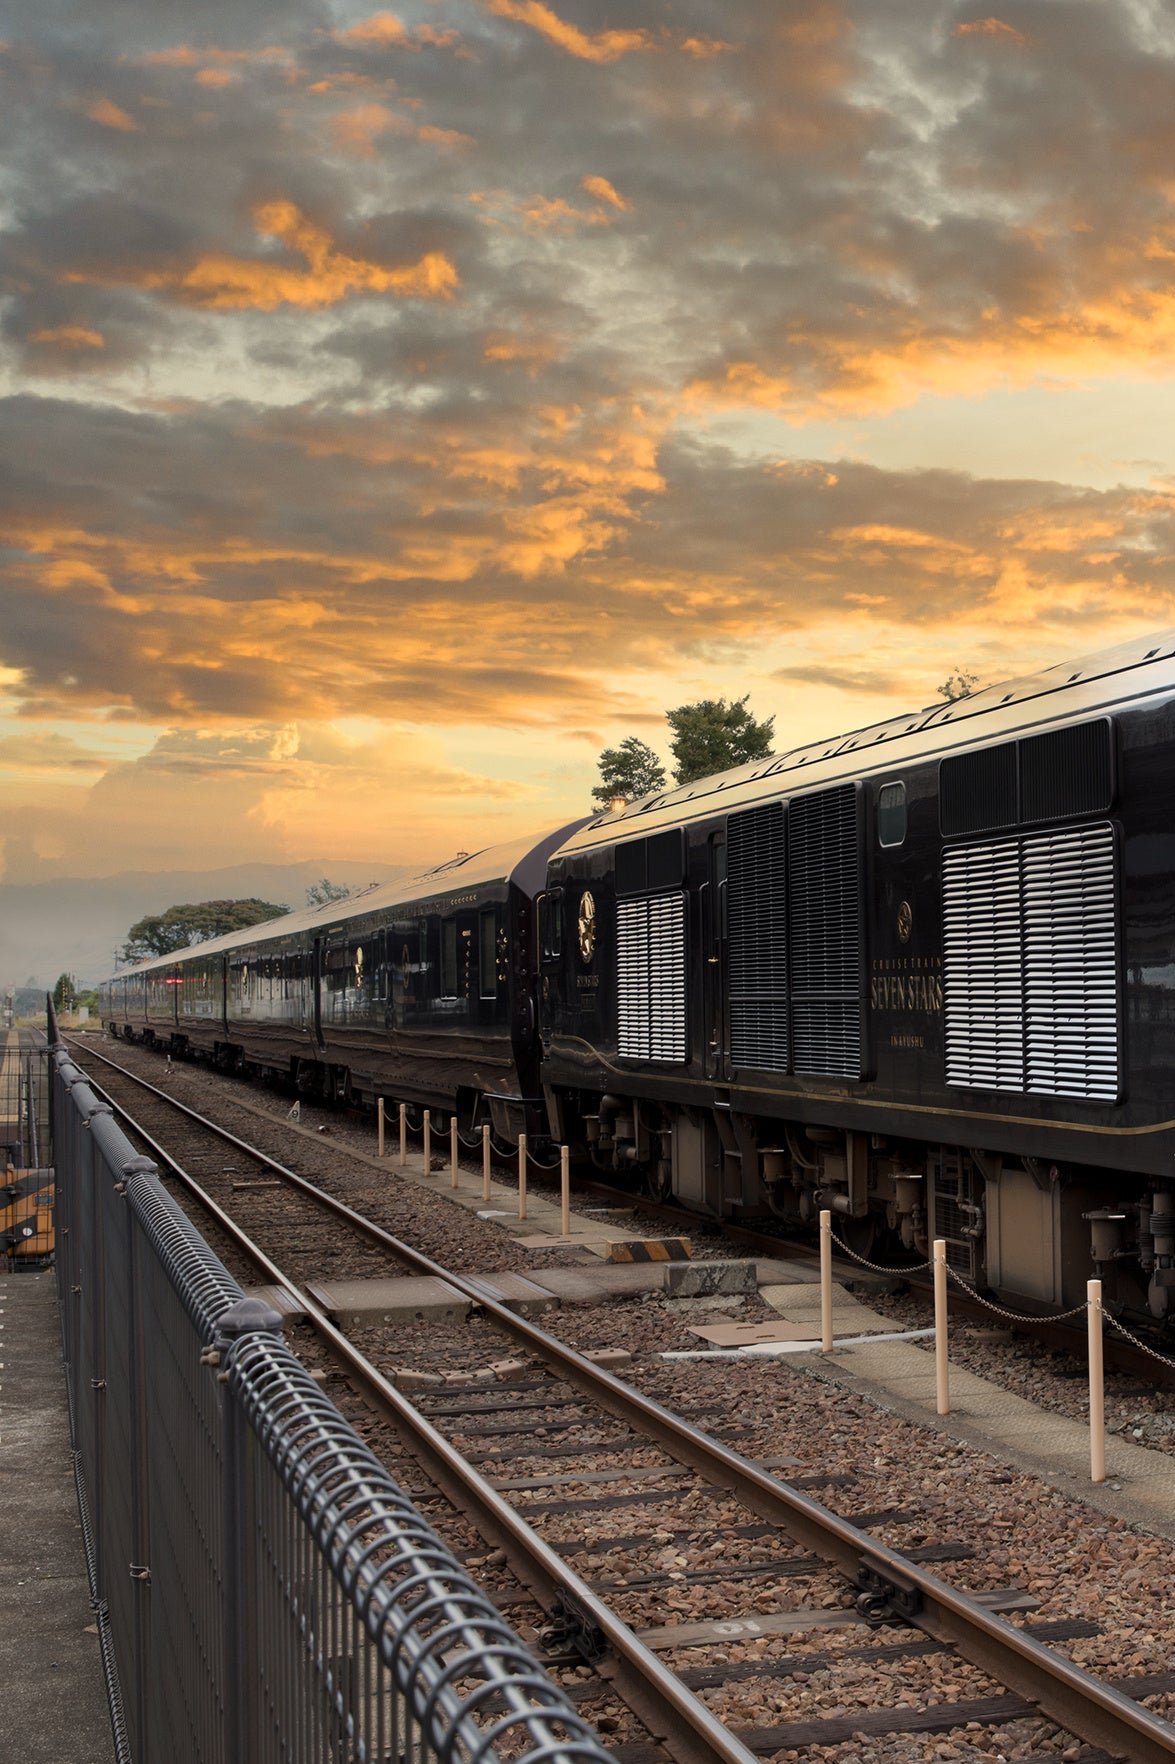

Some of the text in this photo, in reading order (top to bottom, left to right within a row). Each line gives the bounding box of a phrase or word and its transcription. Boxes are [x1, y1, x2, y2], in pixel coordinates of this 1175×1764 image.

[872, 957, 942, 970] CRUISE TRAIN
[871, 975, 943, 1011] SEVEN STARS
[291, 1110, 299, 1119] 9
